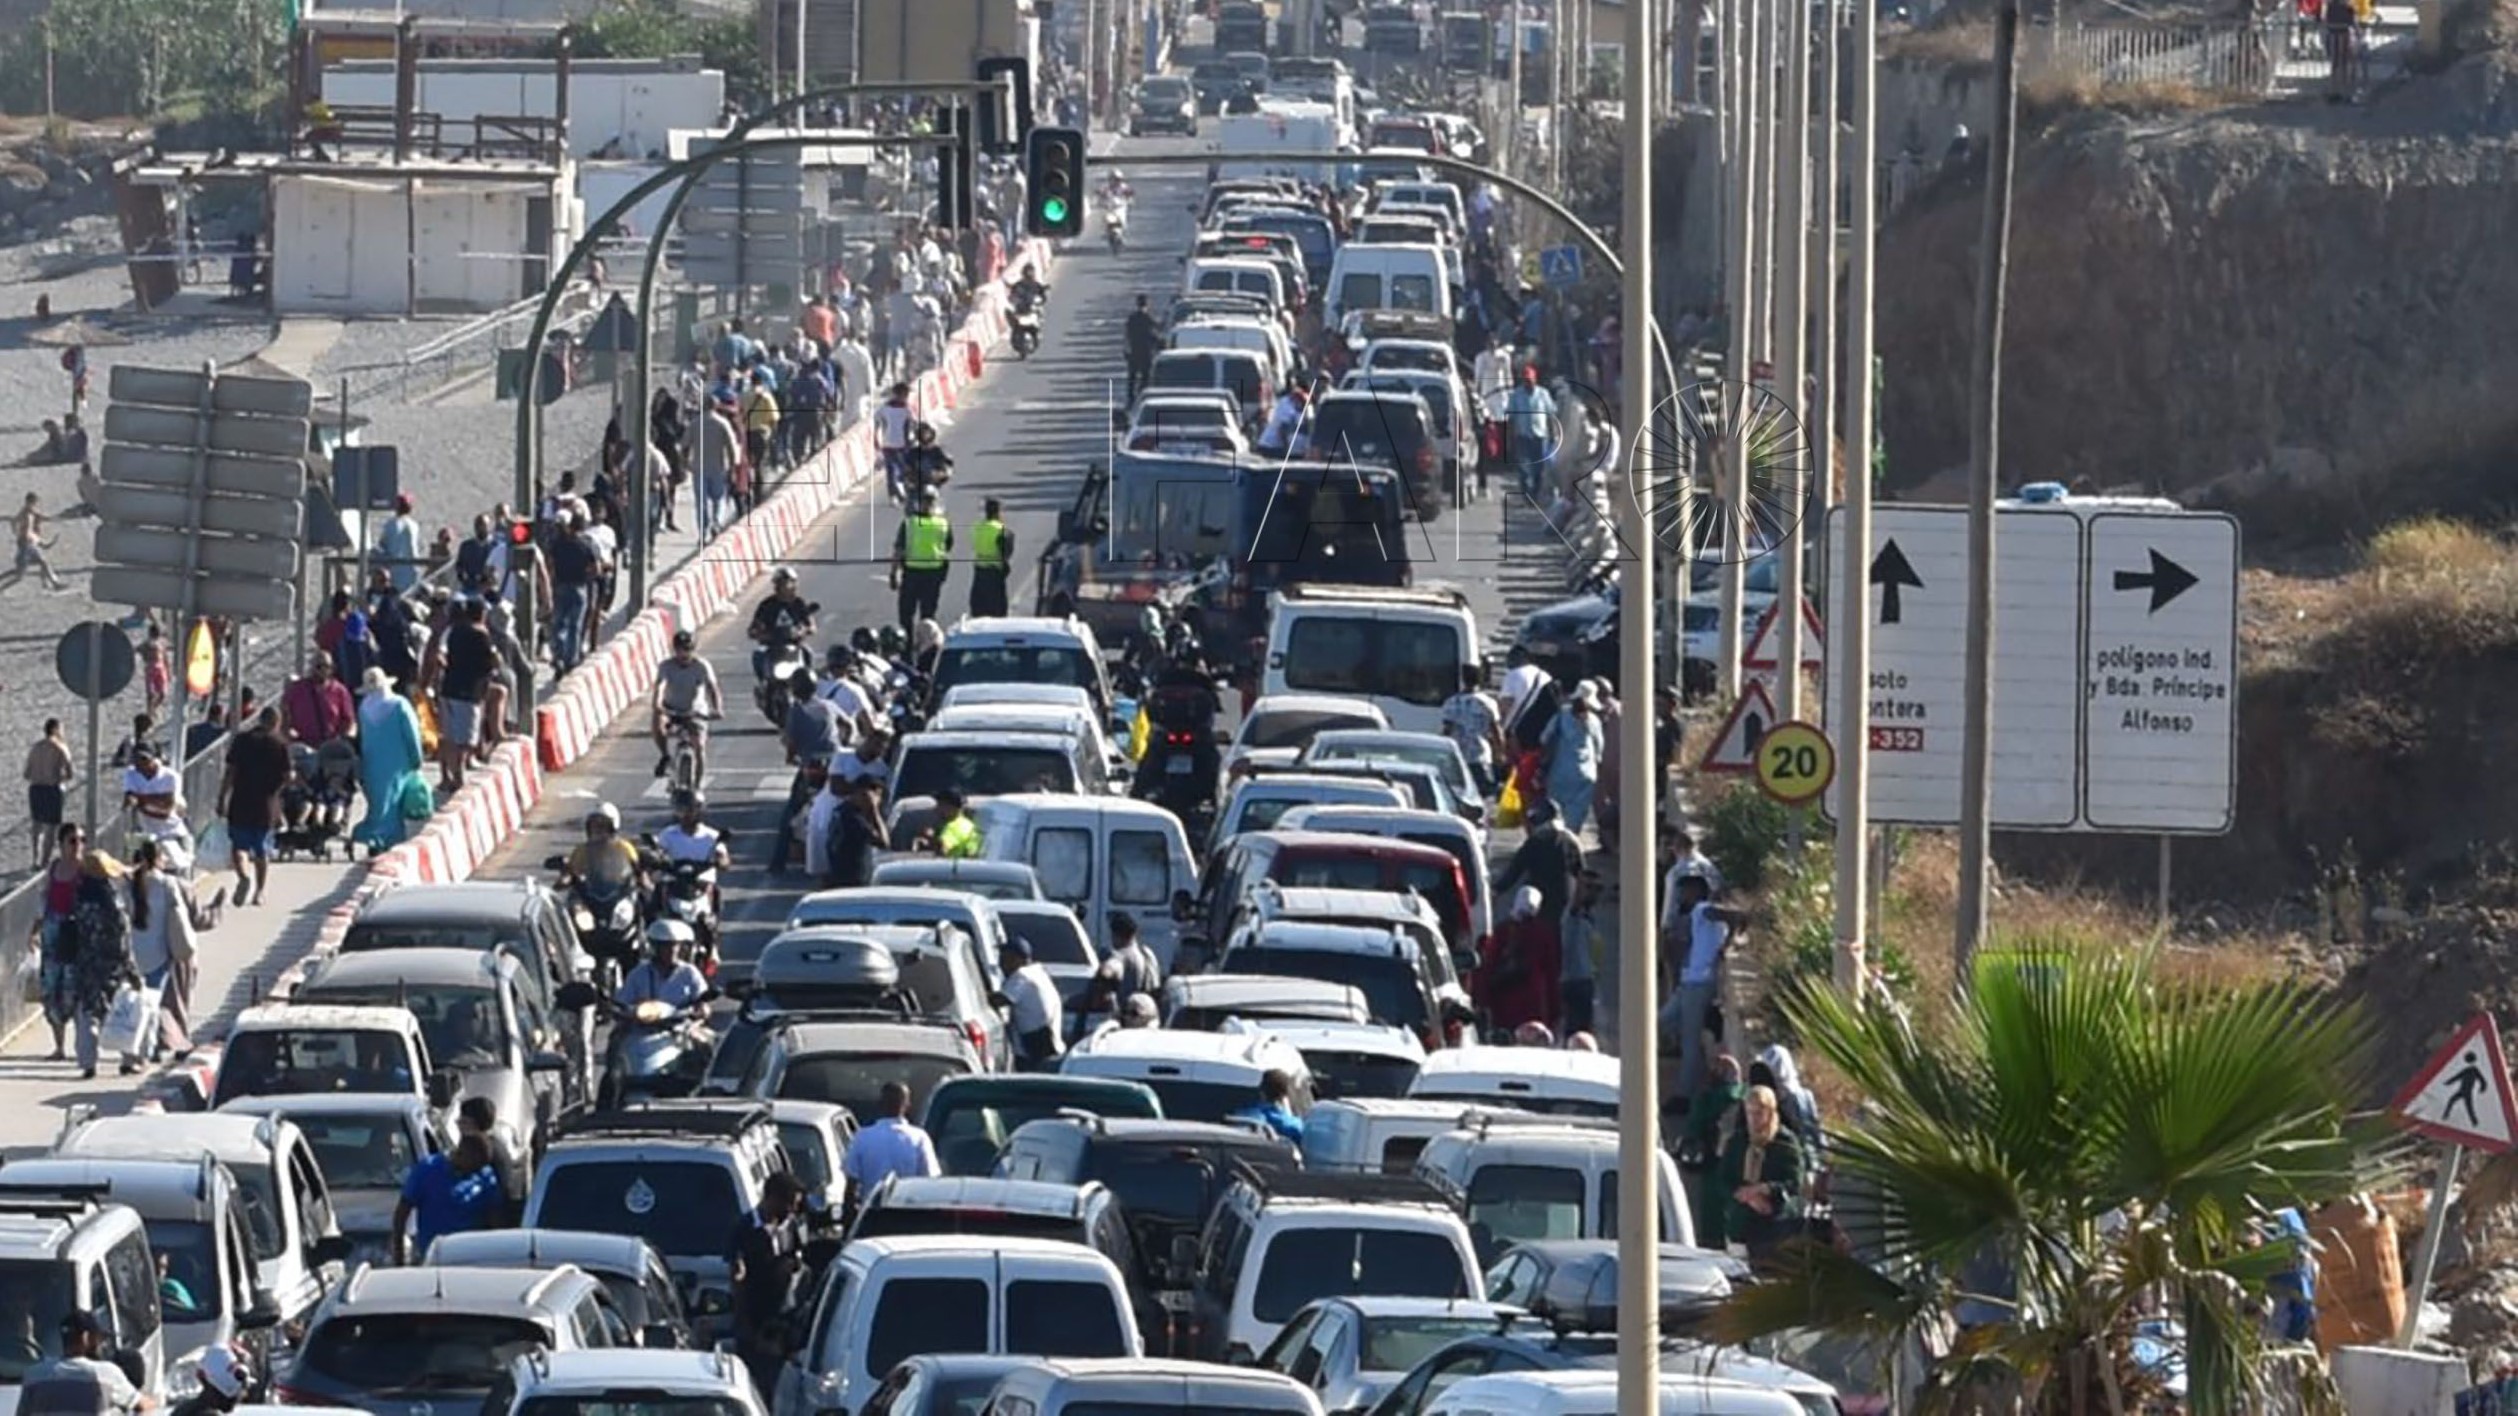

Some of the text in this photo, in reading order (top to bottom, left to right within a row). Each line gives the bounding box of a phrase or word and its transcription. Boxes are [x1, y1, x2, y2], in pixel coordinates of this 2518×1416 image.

[2098, 644, 2178, 674] polígono
[2153, 675, 2225, 701] Príncipe
[1868, 697, 1926, 719] ntera
[2122, 709, 2193, 731] Alfonso
[1871, 729, 1920, 749] -352
[1771, 745, 1818, 779] 20
